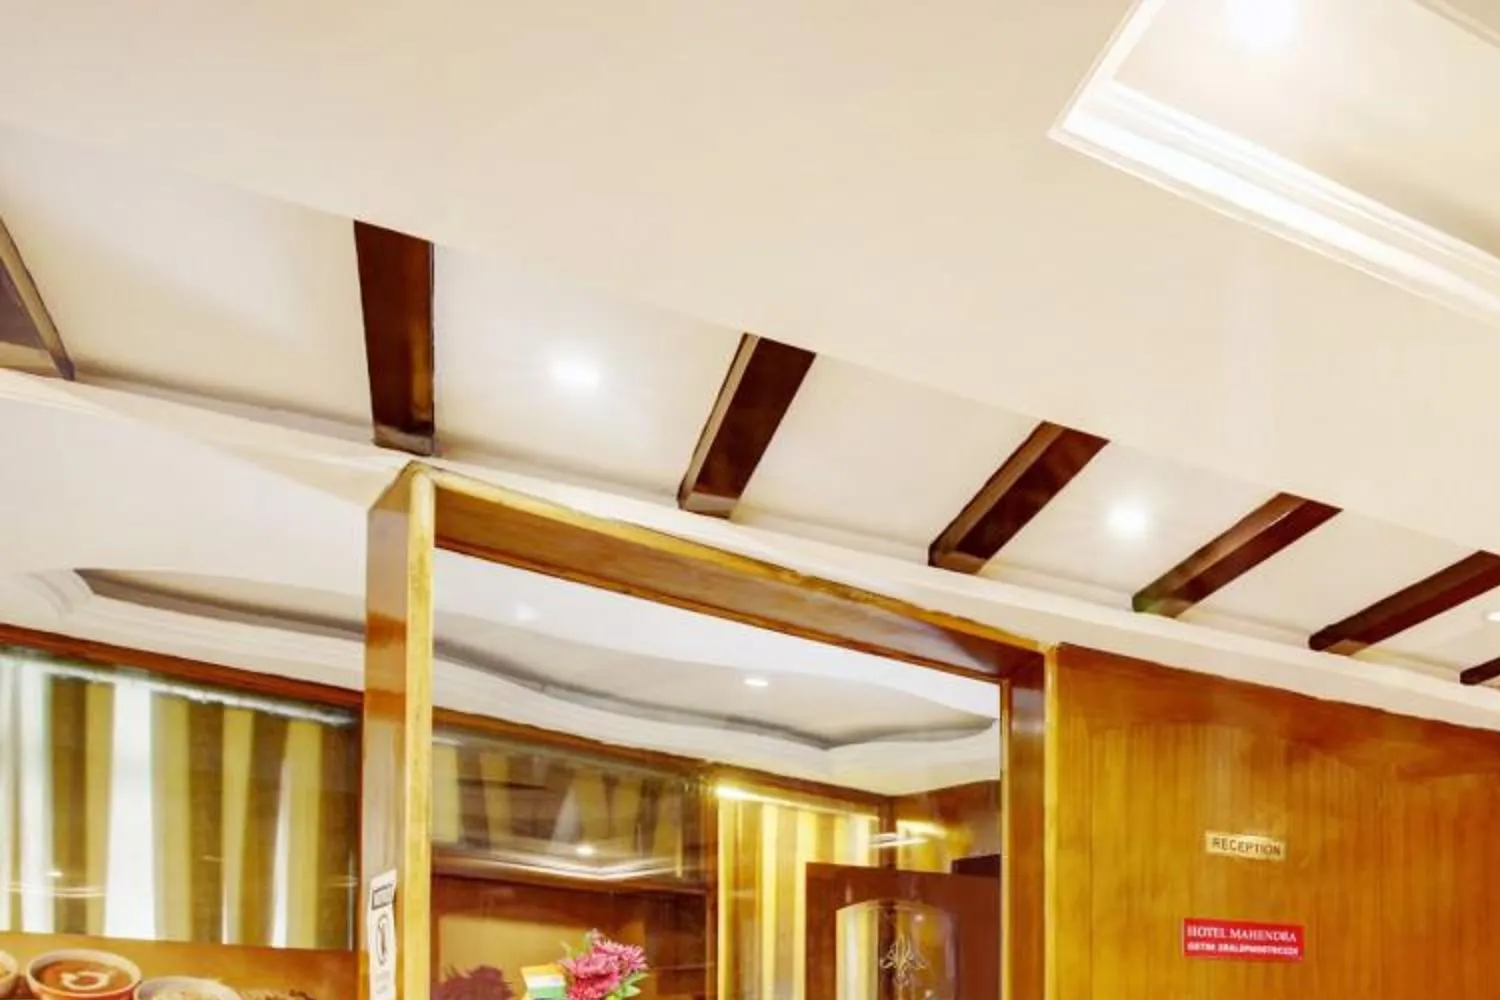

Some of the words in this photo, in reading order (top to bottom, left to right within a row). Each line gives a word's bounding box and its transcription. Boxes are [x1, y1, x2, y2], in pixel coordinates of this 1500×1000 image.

[1212, 837, 1281, 856] RECEPTION
[1187, 925, 1226, 938] HOTEL
[1229, 928, 1297, 942] MAHENDRA
